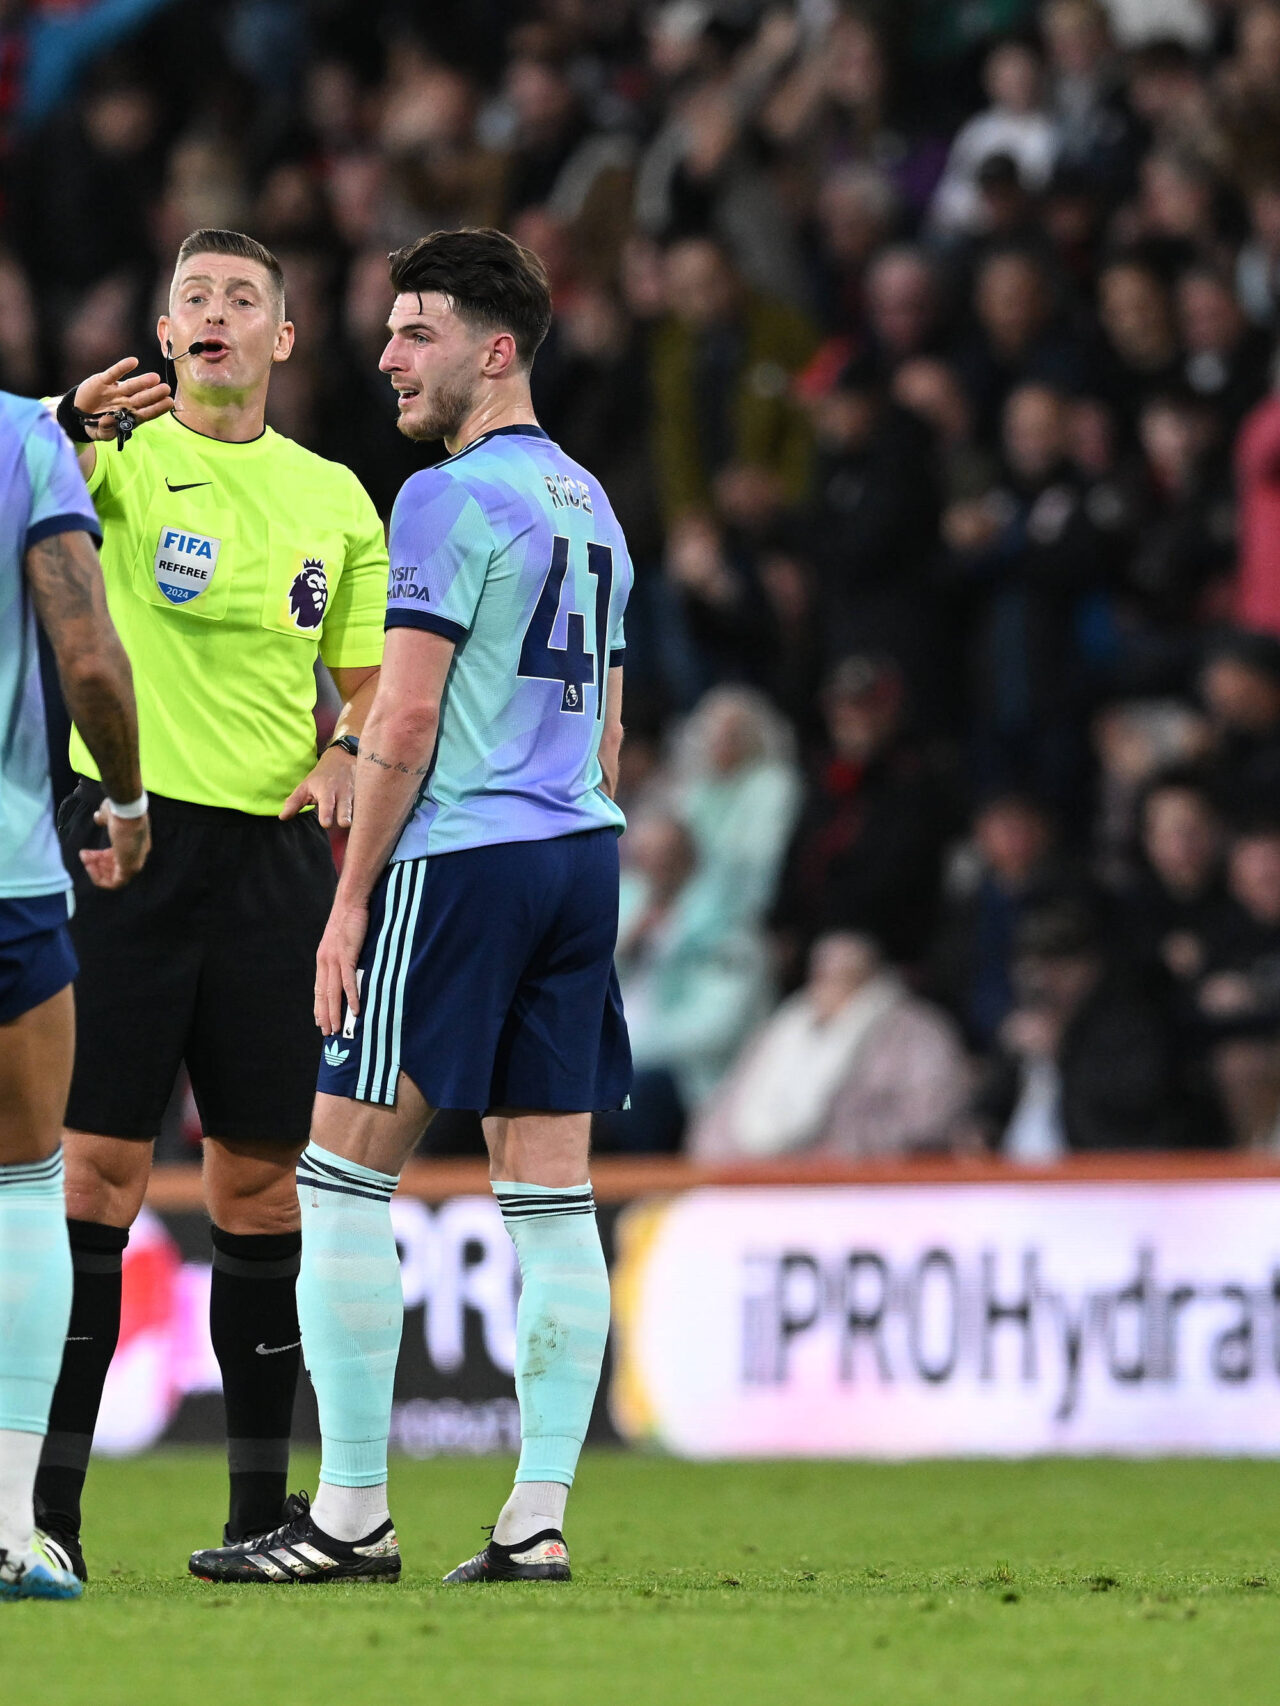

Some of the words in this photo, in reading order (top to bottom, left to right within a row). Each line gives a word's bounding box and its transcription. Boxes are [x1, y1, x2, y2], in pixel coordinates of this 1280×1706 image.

[543, 473, 595, 517] RICE
[163, 531, 212, 560] FIFA
[158, 559, 208, 580] REFEREE
[166, 586, 189, 600] 2024
[516, 534, 613, 722] 41
